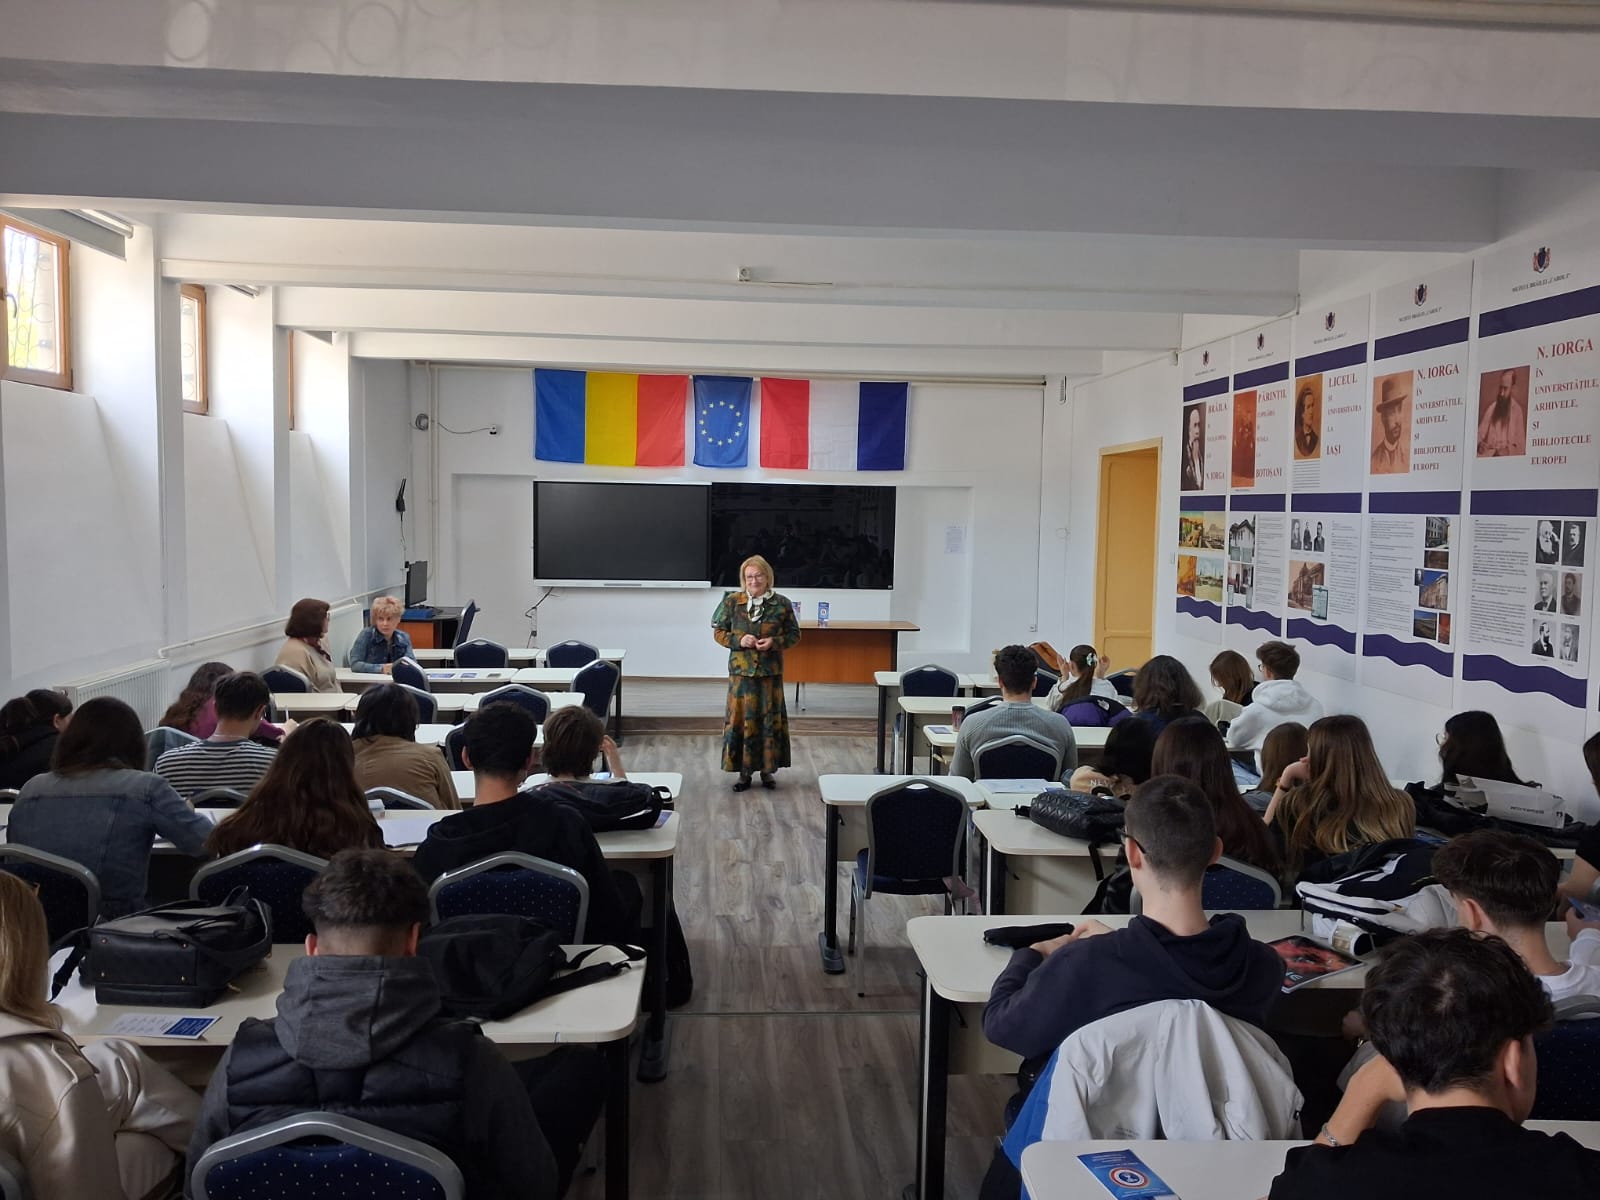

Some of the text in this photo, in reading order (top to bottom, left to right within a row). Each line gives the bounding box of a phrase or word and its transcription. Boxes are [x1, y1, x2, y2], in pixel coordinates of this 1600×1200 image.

[1537, 338, 1593, 360] N. IORGA
[1417, 363, 1460, 380] N. IORGA
[1328, 372, 1358, 388] LICEUL
[1534, 399, 1579, 412] ARHIVELE,
[1531, 434, 1592, 447] BIBLIOTECILE
[1326, 444, 1341, 457] IAȘI
[1413, 444, 1457, 456] BIBLIOTECILE
[1413, 462, 1440, 472] EUROPEI
[1530, 455, 1567, 466] EUROPEI
